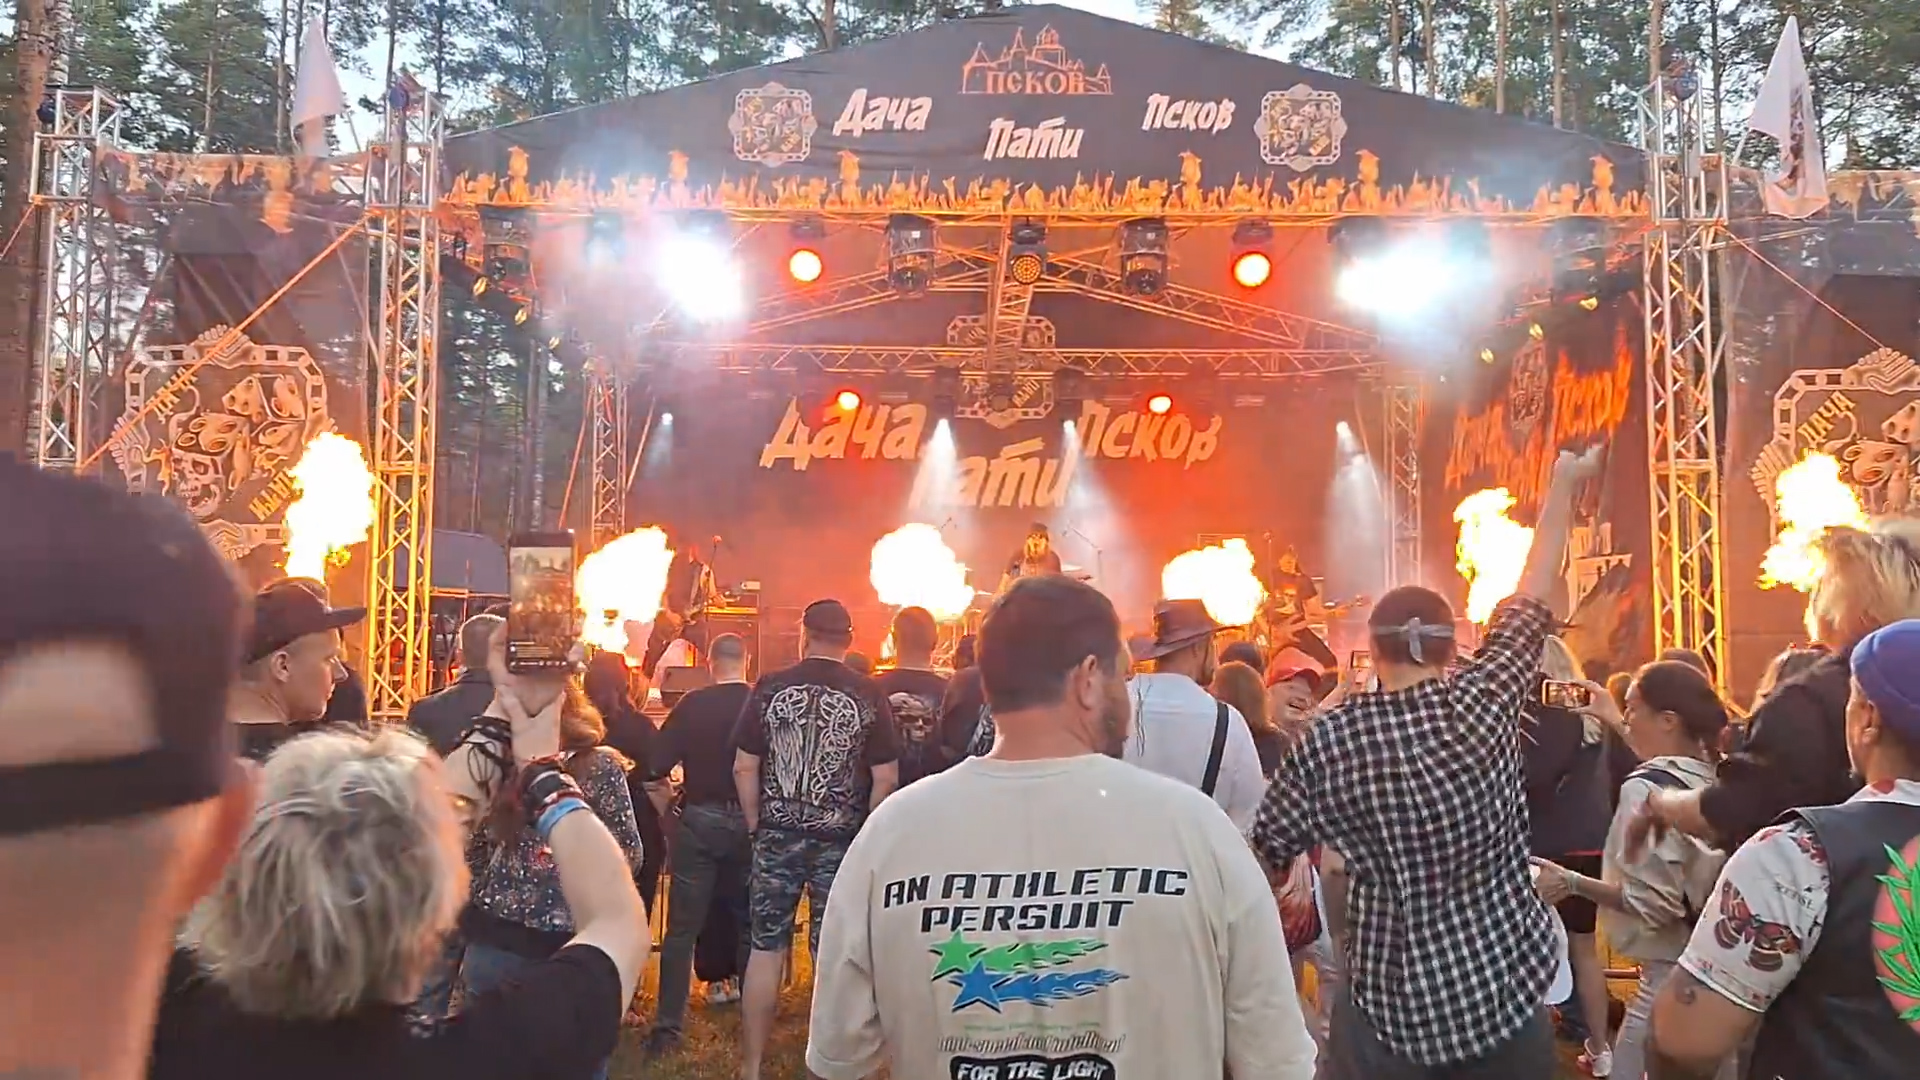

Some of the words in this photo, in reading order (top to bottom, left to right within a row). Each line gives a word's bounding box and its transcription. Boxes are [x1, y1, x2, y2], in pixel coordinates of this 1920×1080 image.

[986, 70, 1085, 95] ПСКОВ
[833, 88, 932, 138] Дача
[1141, 93, 1236, 135] Псков
[983, 116, 1085, 161] Пати
[758, 395, 927, 471] Дача
[1072, 397, 1223, 471] Псков
[1797, 390, 1856, 450] ДАЧА
[883, 874, 931, 910] AN
[940, 867, 1189, 900] ATHLETIC
[920, 899, 1136, 934] PERSUIT
[957, 1062, 999, 1080] FOR
[1006, 1060, 1048, 1080] THE
[1052, 1059, 1109, 1080] LIGHT
